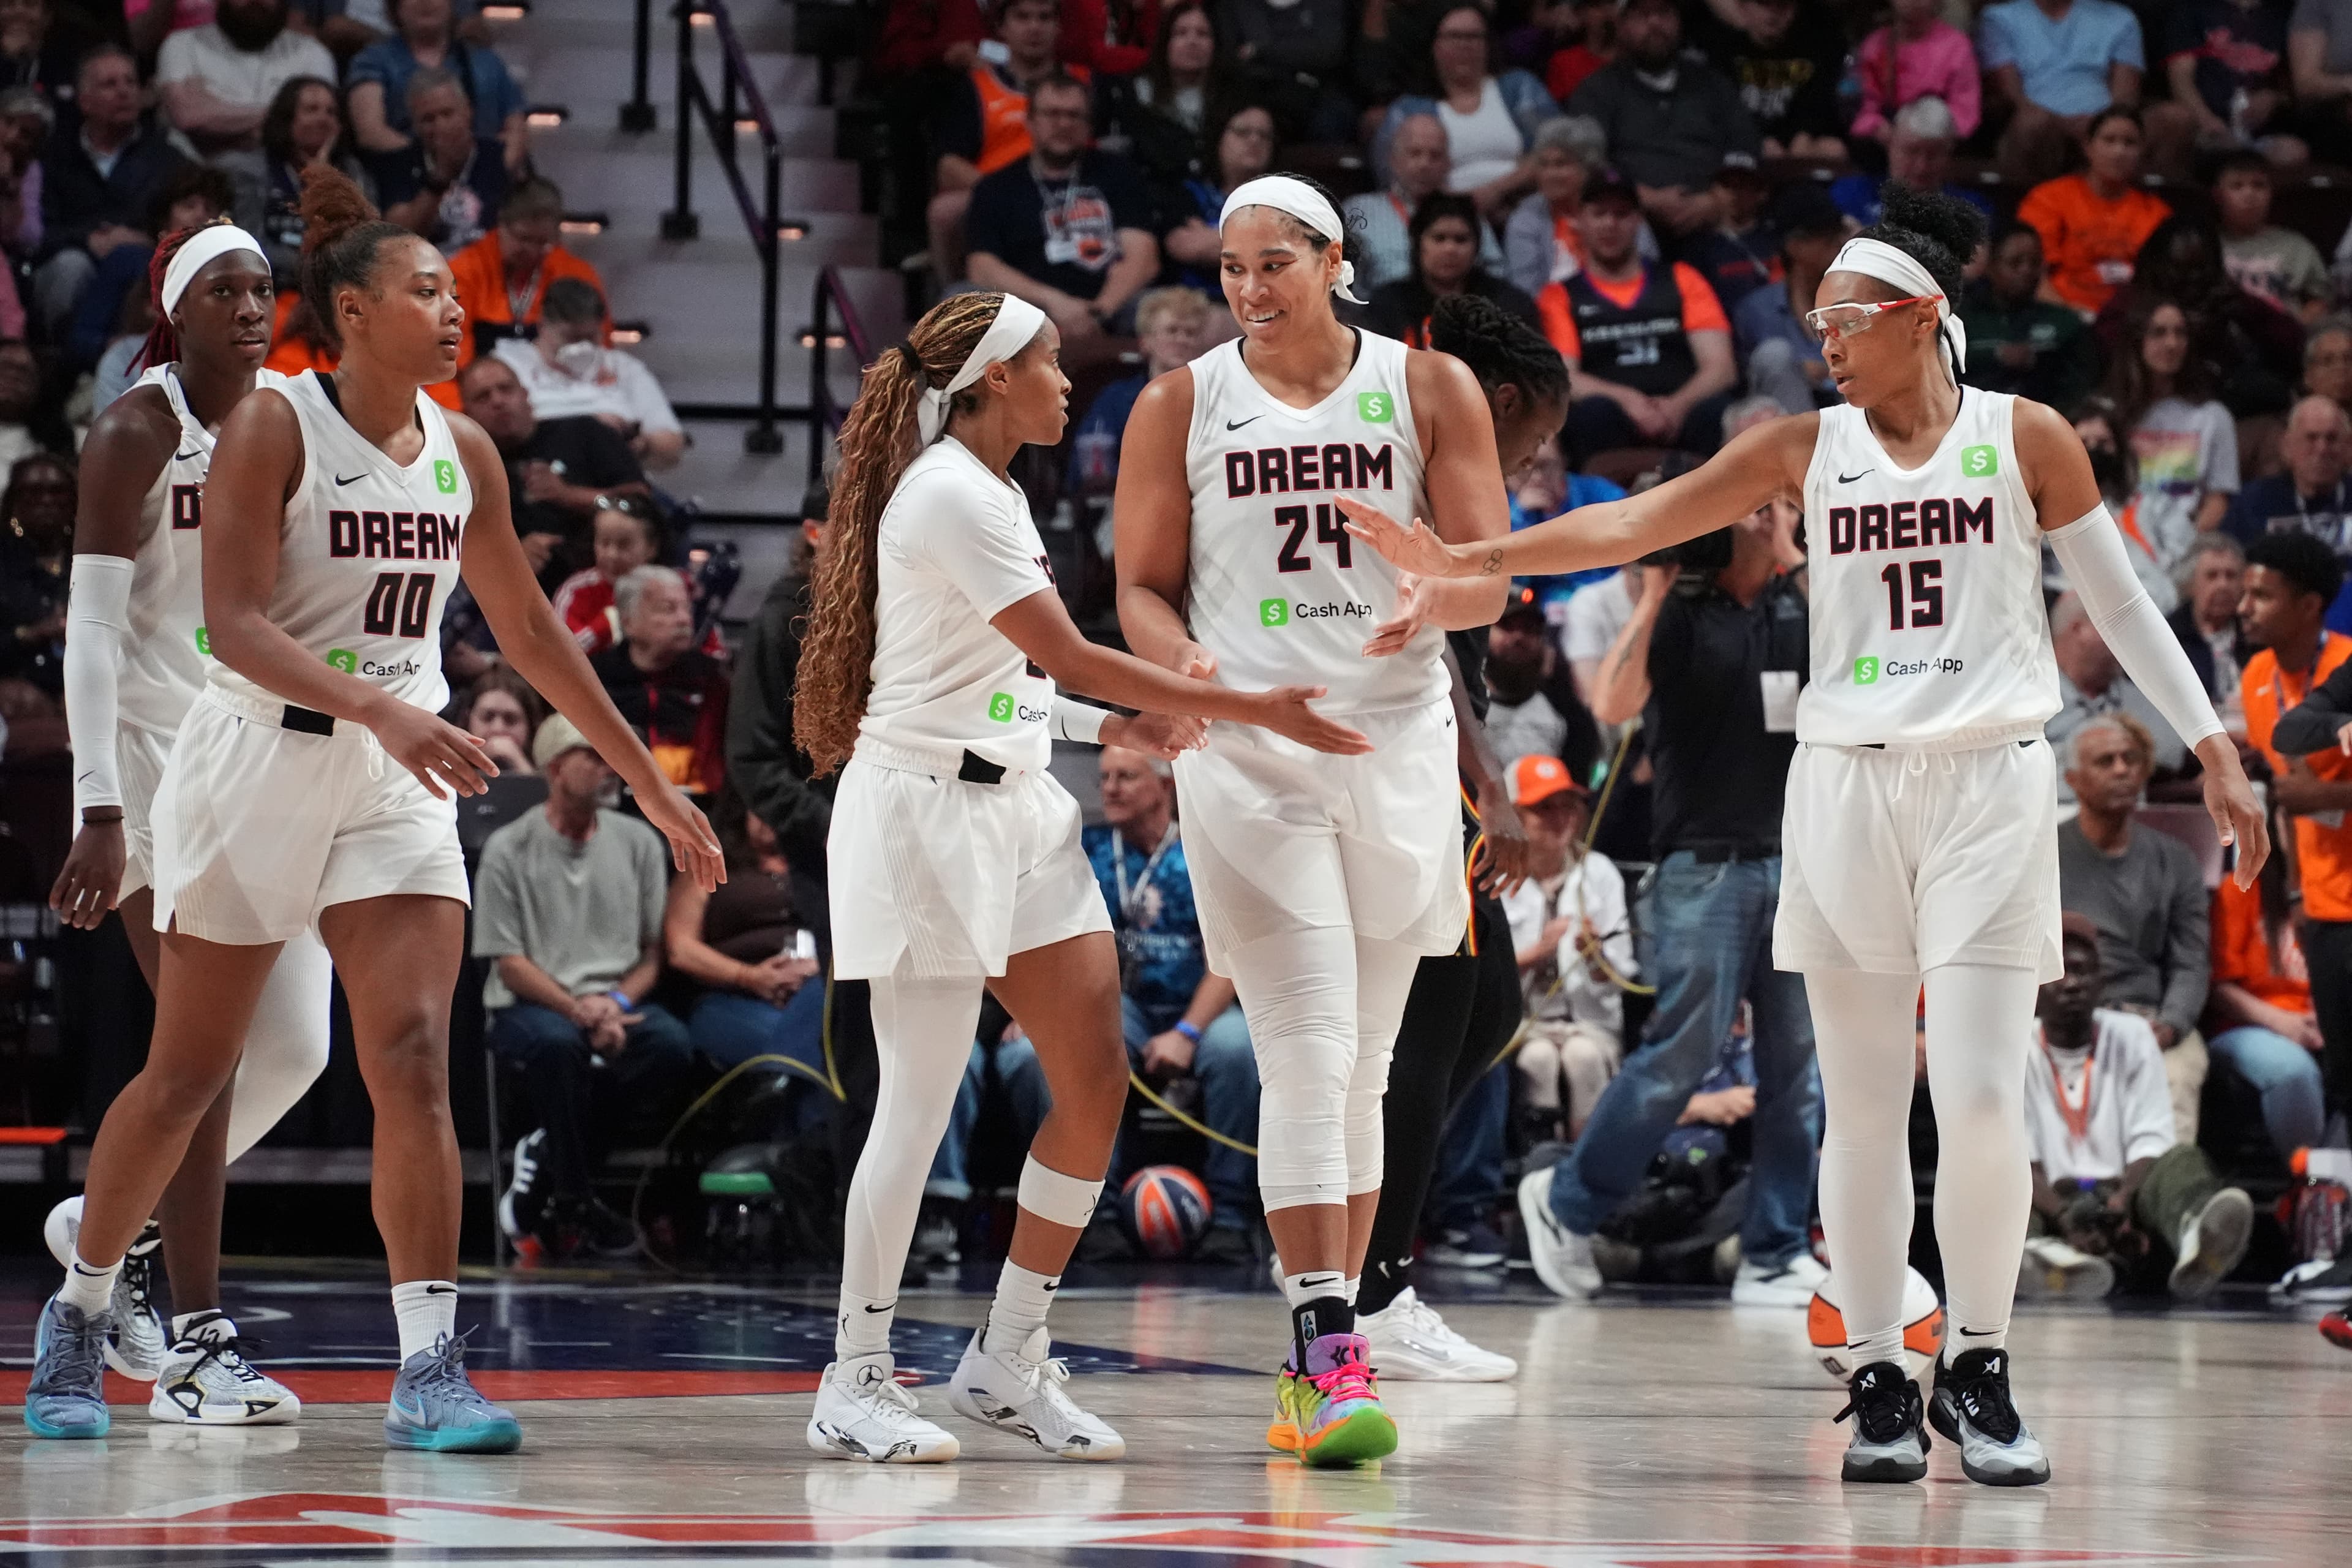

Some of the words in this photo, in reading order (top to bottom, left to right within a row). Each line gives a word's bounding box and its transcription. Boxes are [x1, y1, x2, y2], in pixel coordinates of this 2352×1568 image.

[1225, 443, 1393, 499] DREAM
[328, 510, 461, 562] DREAM
[1274, 503, 1353, 573] 24
[1828, 497, 1994, 556] DREAM
[363, 572, 436, 639] 00
[1295, 601, 1340, 618] Cash
[1880, 559, 1944, 631] 15
[1886, 659, 1928, 676] Cash
[1930, 657, 1964, 674] App
